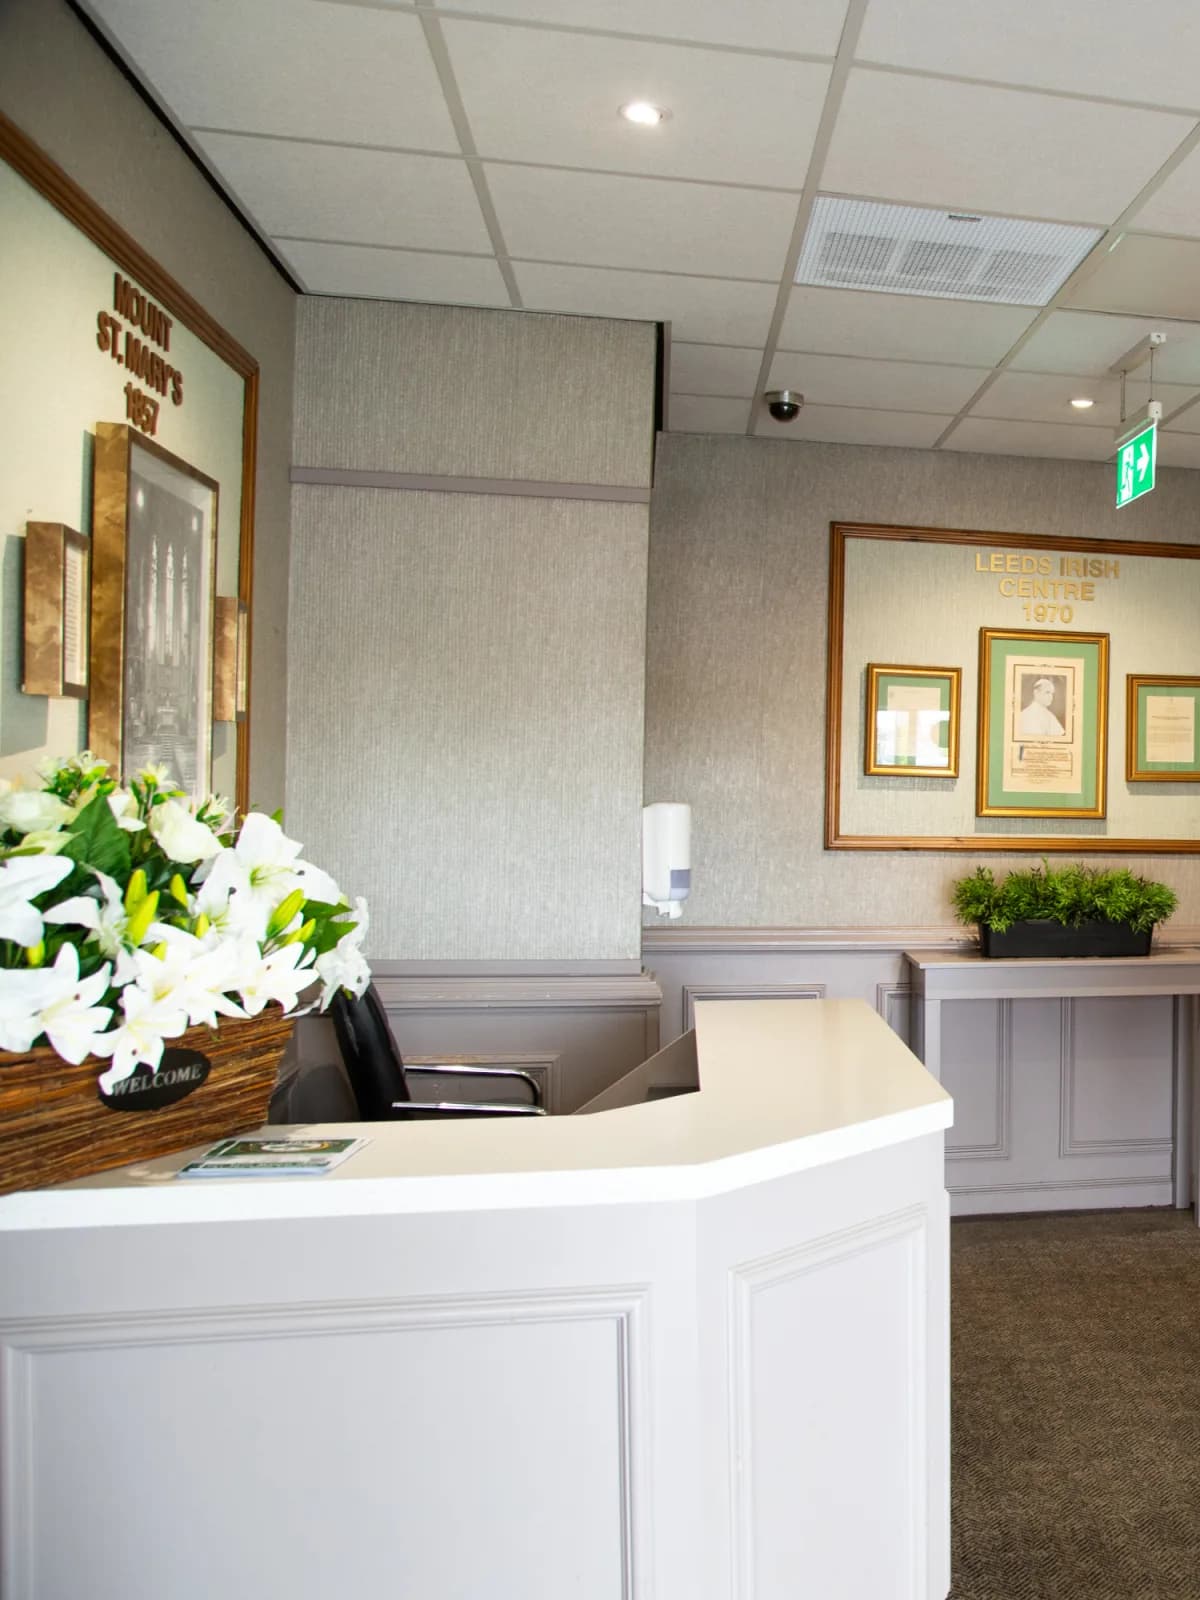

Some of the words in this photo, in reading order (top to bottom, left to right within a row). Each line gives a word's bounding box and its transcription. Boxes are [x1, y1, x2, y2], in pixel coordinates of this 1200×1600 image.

[113, 272, 173, 352] MOUNT
[96, 310, 124, 365] ST.
[125, 331, 184, 407] MARY'S
[123, 381, 160, 436] 1857
[975, 552, 1053, 575] LEEDS
[1059, 556, 1121, 579] IRISH
[999, 577, 1096, 601] CENTRE
[1022, 601, 1074, 624] 1970
[112, 1063, 203, 1097] WELCOME
